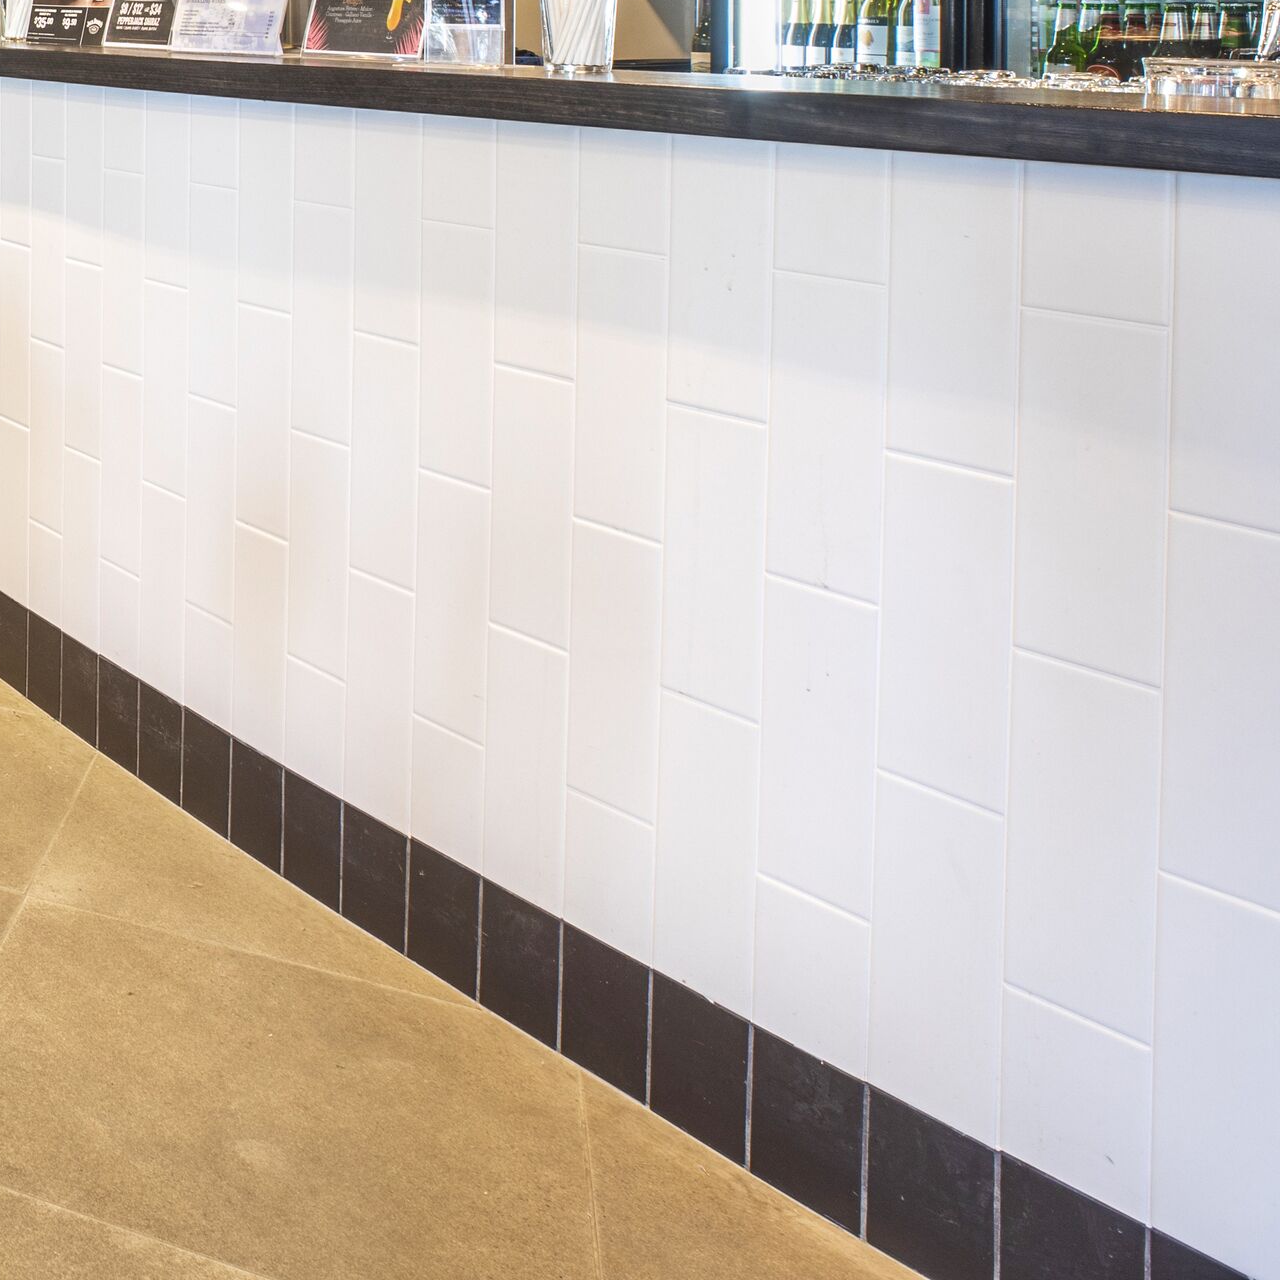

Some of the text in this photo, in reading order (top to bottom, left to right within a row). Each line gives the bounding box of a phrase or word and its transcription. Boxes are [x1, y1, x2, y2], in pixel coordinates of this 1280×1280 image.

[132, 2, 144, 16] $12
[149, 2, 162, 15] $34
[117, 16, 145, 26] PEPPERJACK
